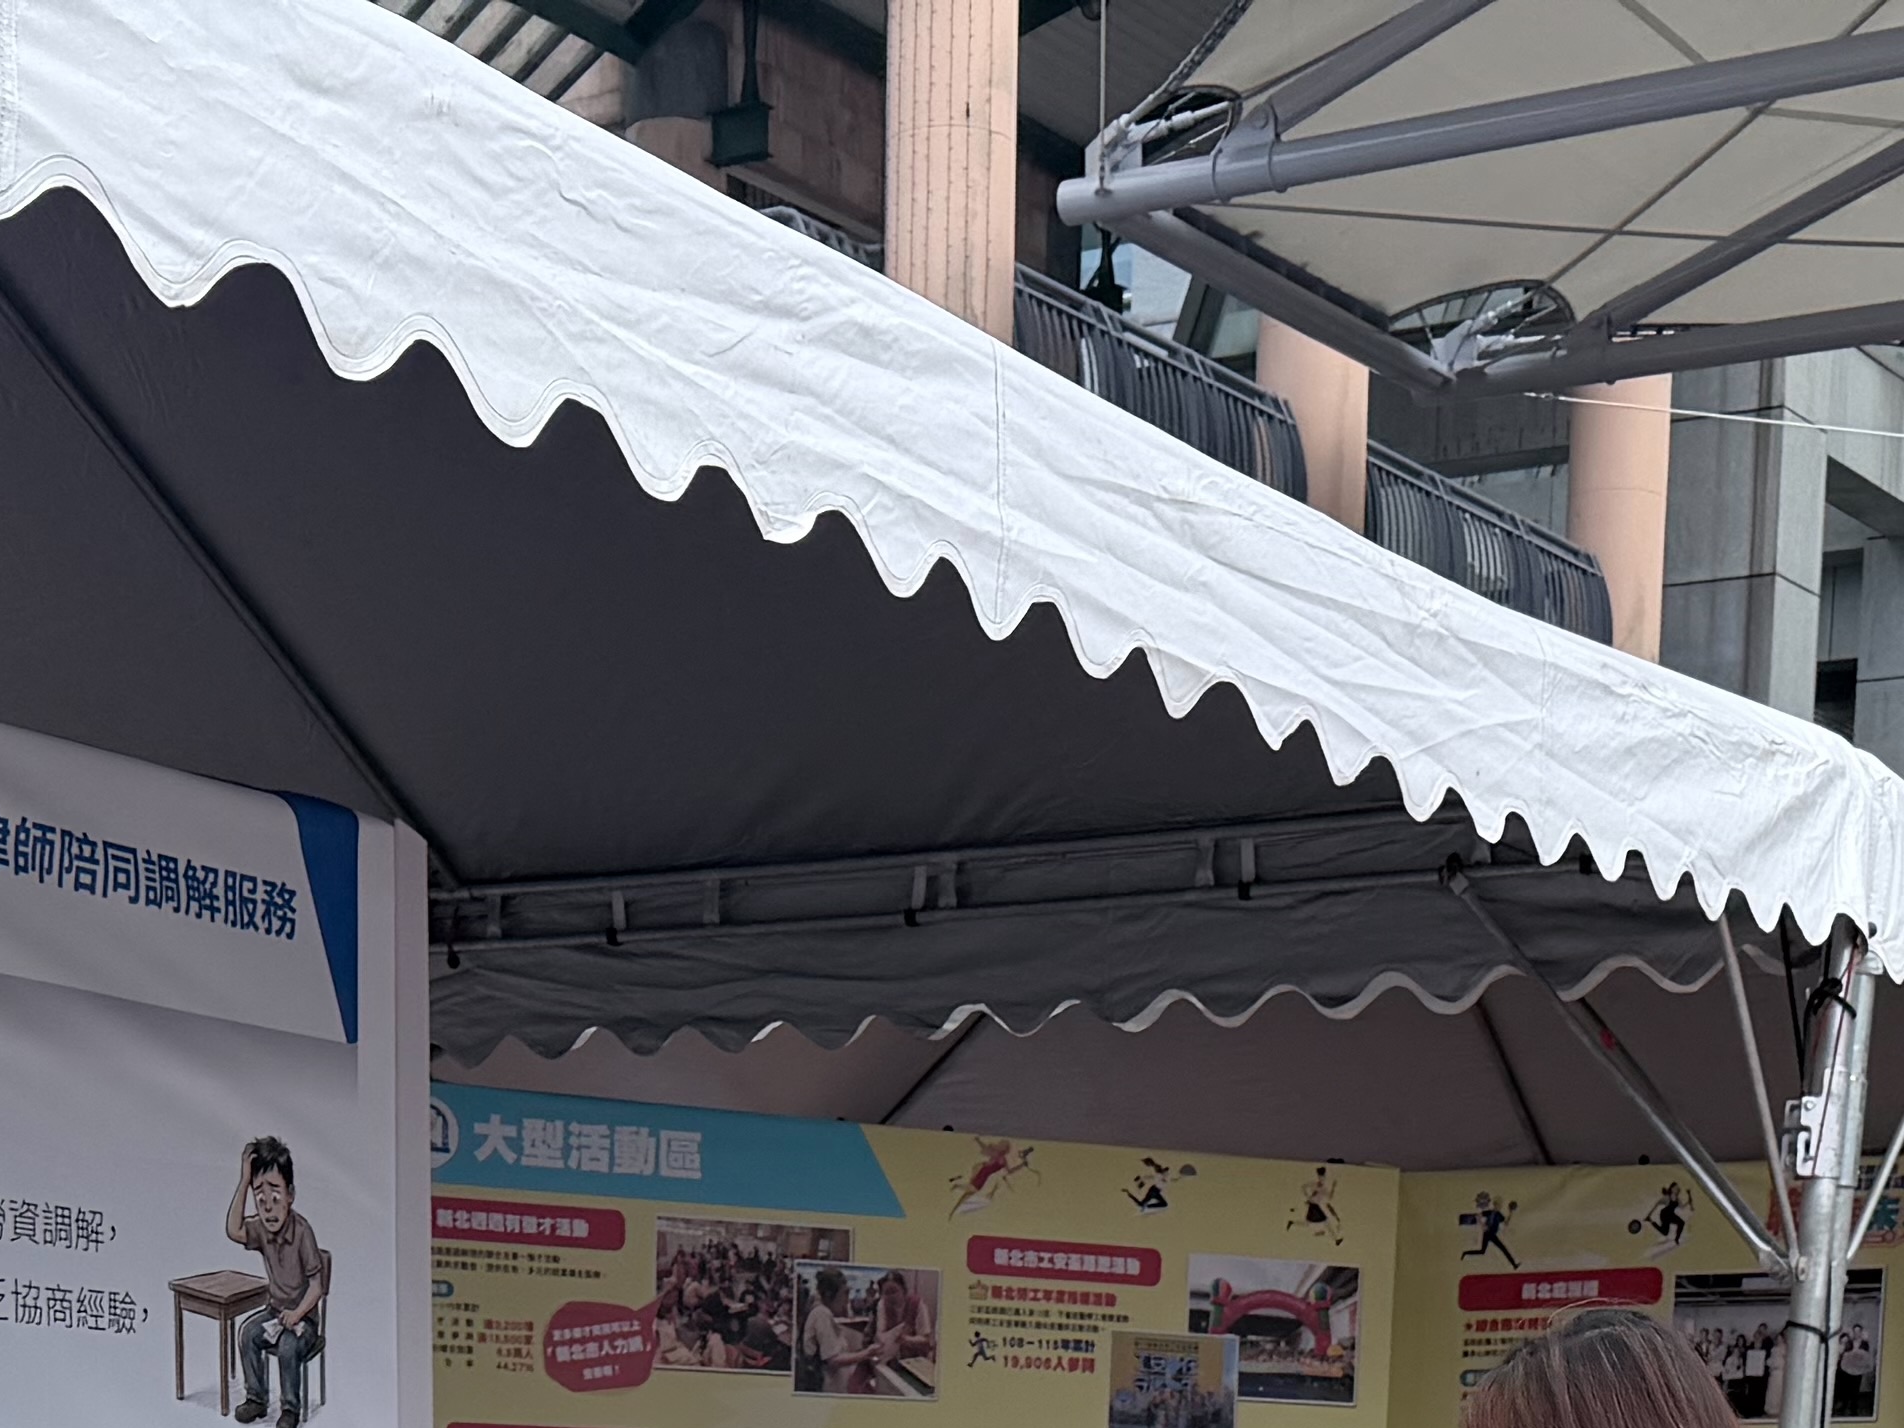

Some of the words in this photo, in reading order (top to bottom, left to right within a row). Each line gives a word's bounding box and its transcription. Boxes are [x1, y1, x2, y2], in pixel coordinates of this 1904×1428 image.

[473, 1115, 702, 1180] 大型活動區
